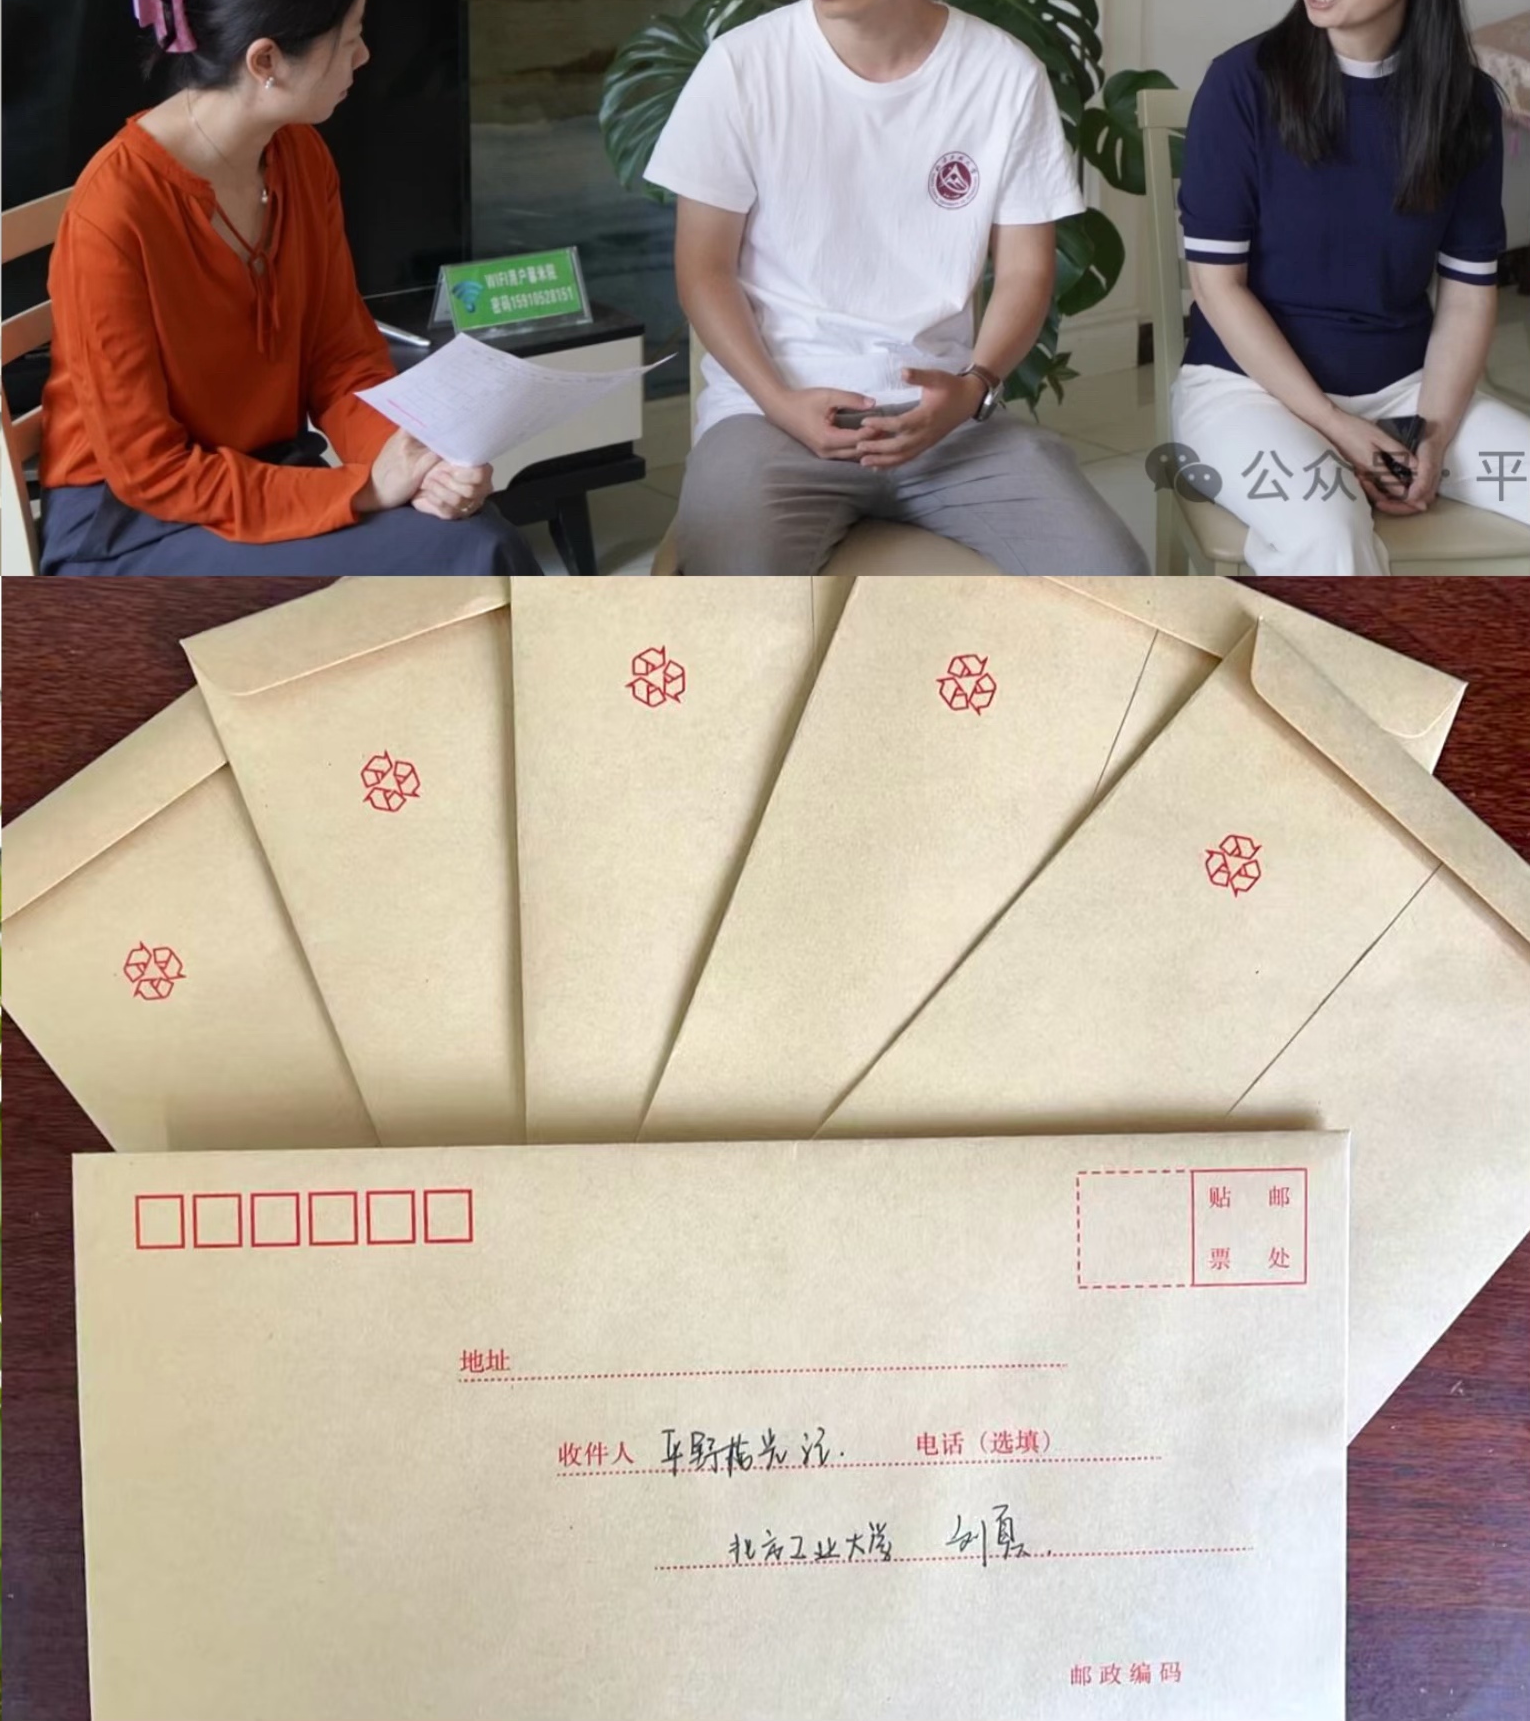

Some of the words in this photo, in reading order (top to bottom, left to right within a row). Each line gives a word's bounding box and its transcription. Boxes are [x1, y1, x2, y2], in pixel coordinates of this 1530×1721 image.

[459, 1349, 511, 1374] 地址
[557, 1439, 635, 1467] 收件人
[728, 1520, 893, 1563] 北方工业大学
[1069, 1660, 1183, 1687] 邮政编码
